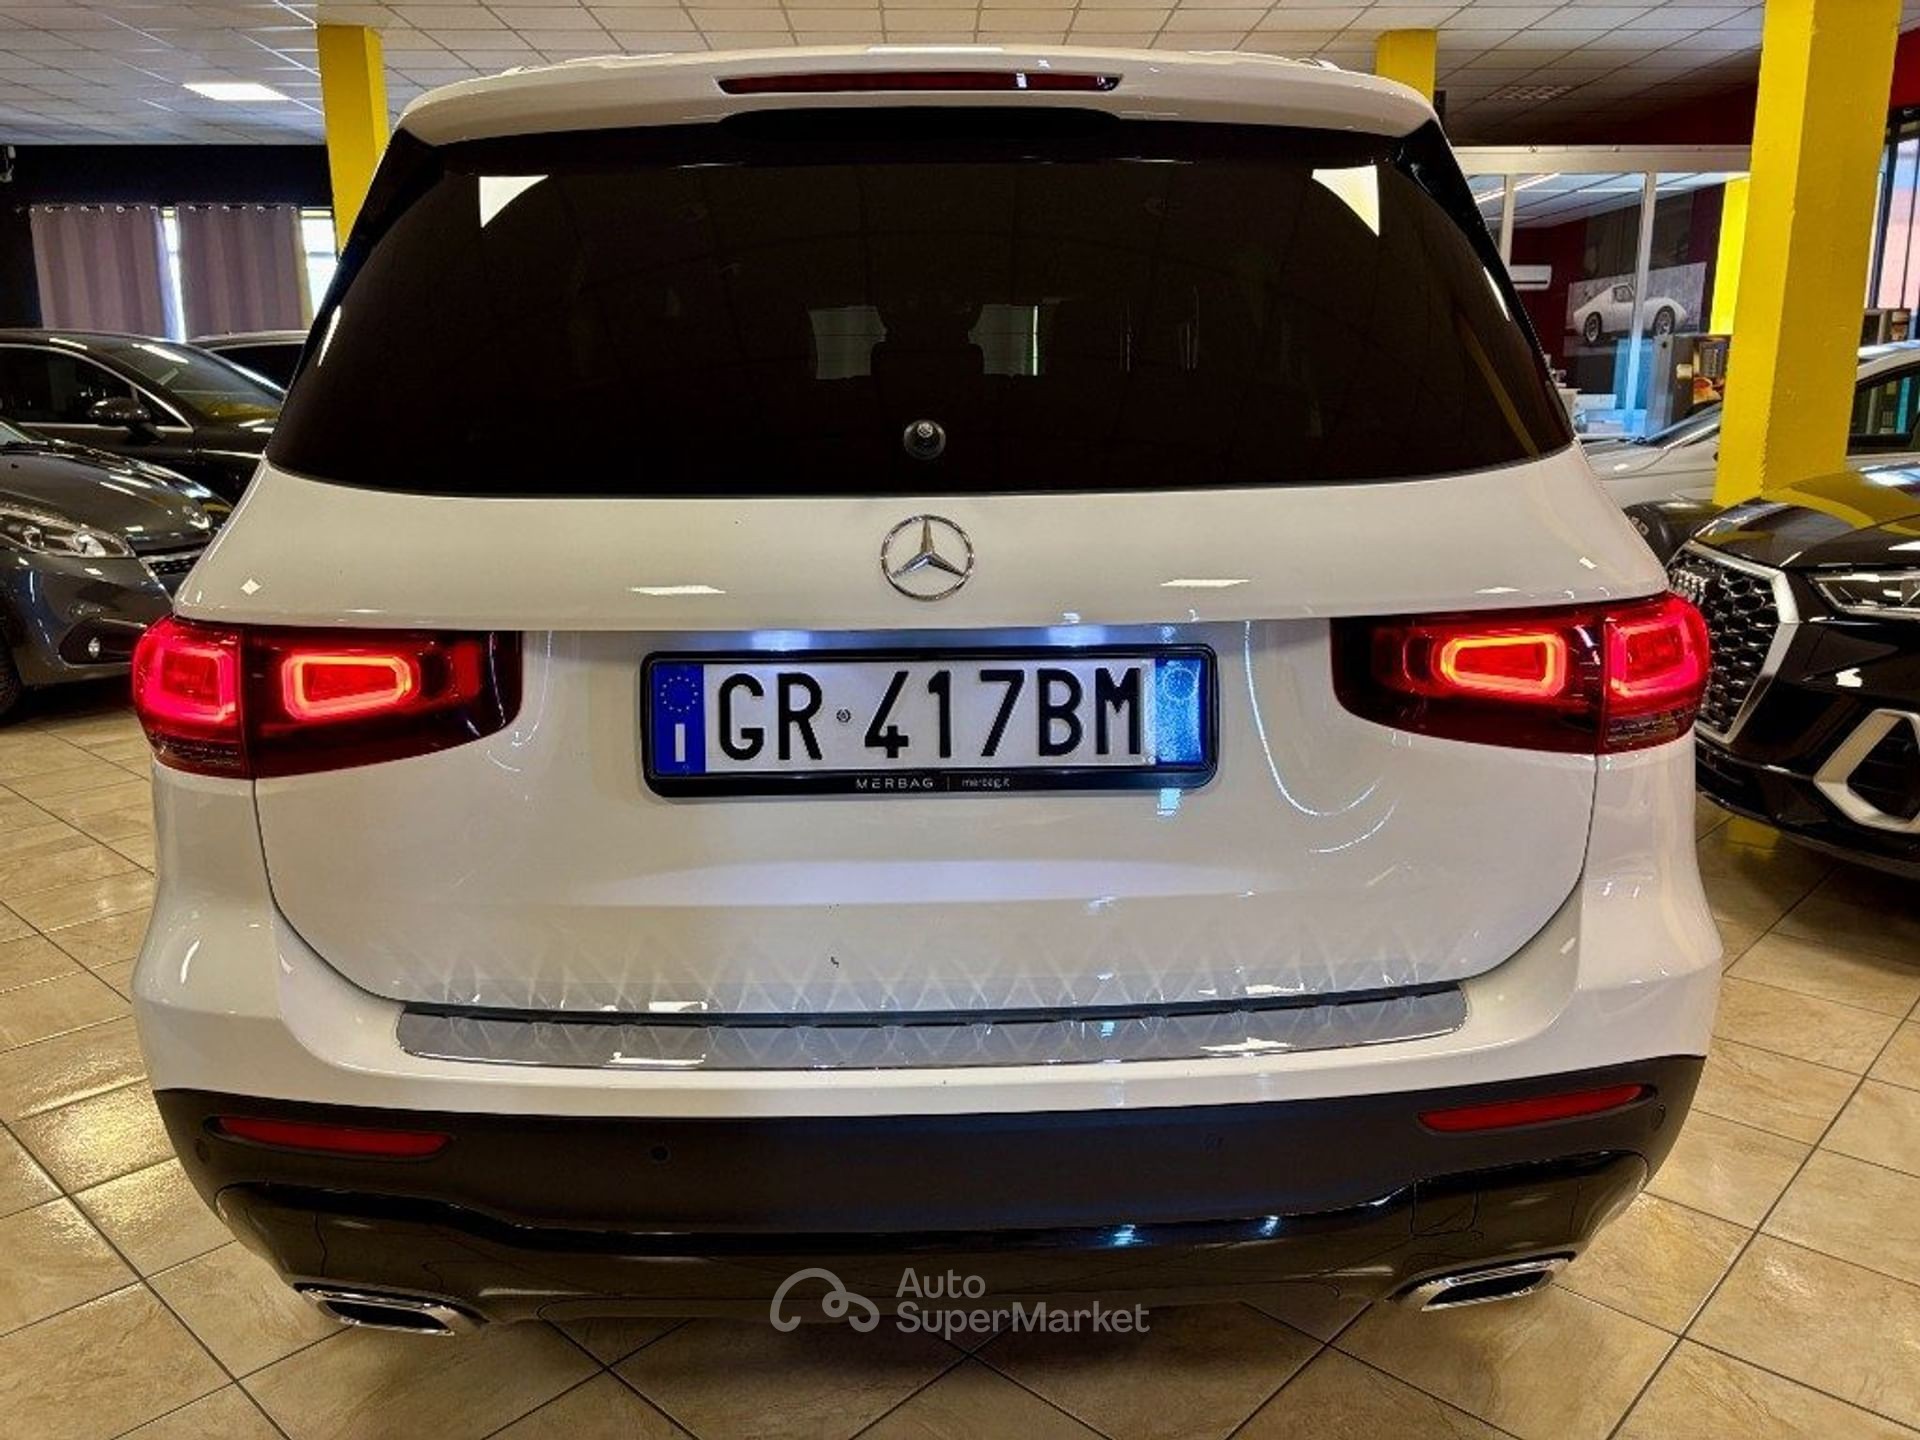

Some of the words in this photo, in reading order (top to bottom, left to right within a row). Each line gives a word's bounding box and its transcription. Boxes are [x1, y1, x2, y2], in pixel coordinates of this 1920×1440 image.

[717, 671, 823, 762] GR
[863, 667, 1142, 760] 417BM
[675, 723, 685, 762] I
[856, 777, 934, 790] MERBAG
